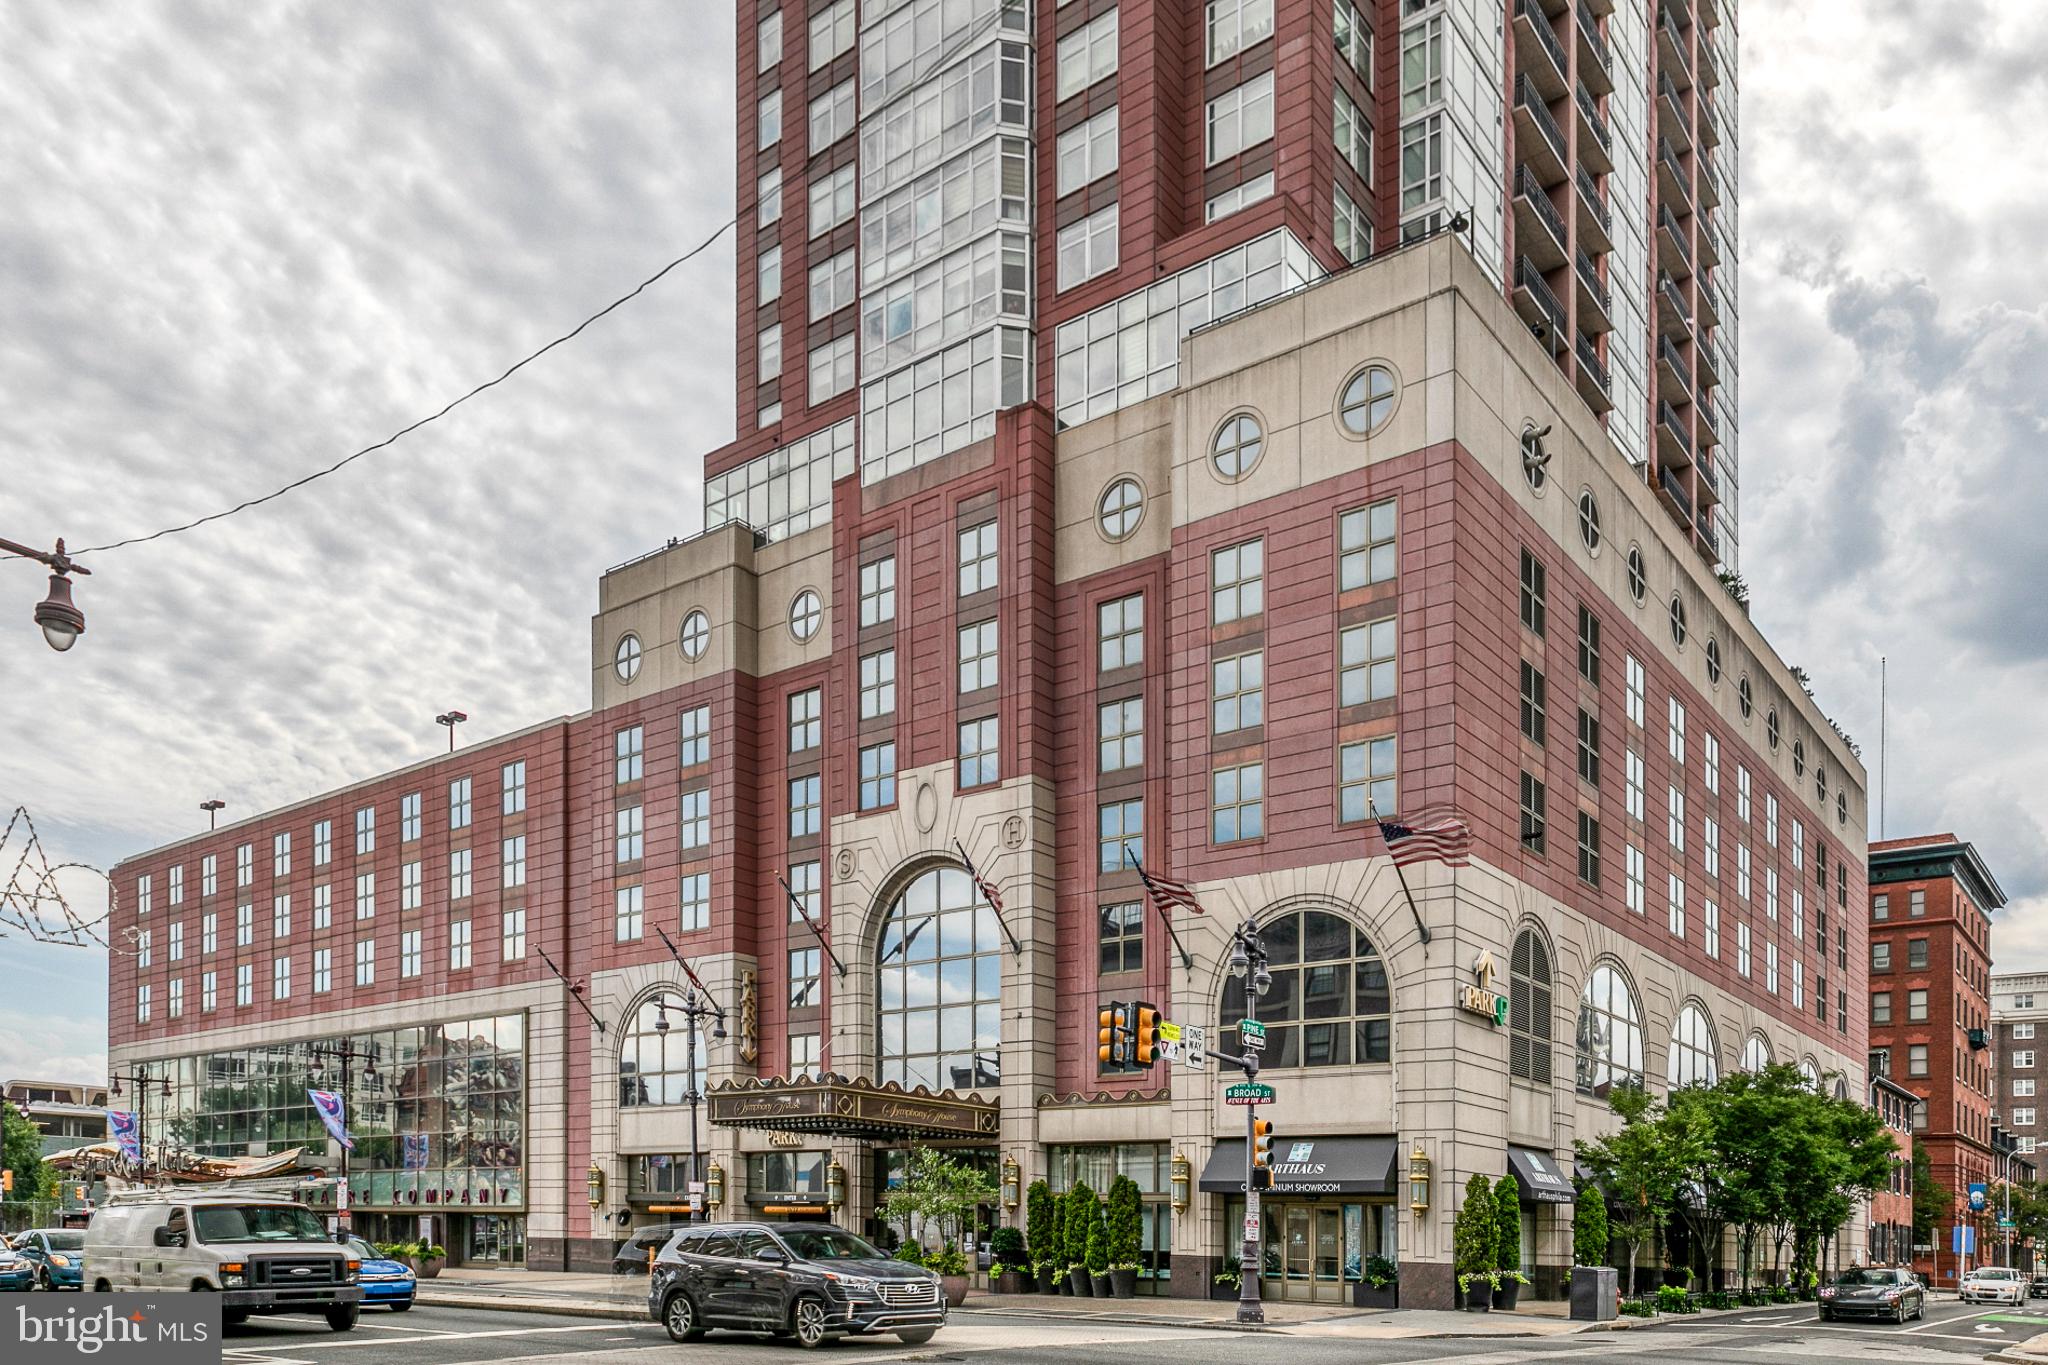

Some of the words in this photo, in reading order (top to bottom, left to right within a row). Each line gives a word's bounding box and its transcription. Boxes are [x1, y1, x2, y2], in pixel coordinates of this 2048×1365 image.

[741, 969, 757, 1038] PARK
[1465, 985, 1496, 1015] PARK
[1189, 1028, 1202, 1041] ONE
[1247, 1024, 1259, 1034] PINE
[1189, 1040, 1202, 1052] WAY
[1234, 1089, 1261, 1097] BROAD
[734, 1098, 772, 1117] Symphony
[881, 1103, 928, 1120] Symphony
[926, 1109, 957, 1123] House
[1274, 1163, 1326, 1175] RTHAUS
[1295, 1184, 1341, 1192] SHOWROOM
[393, 1188, 510, 1205] COMPANY
